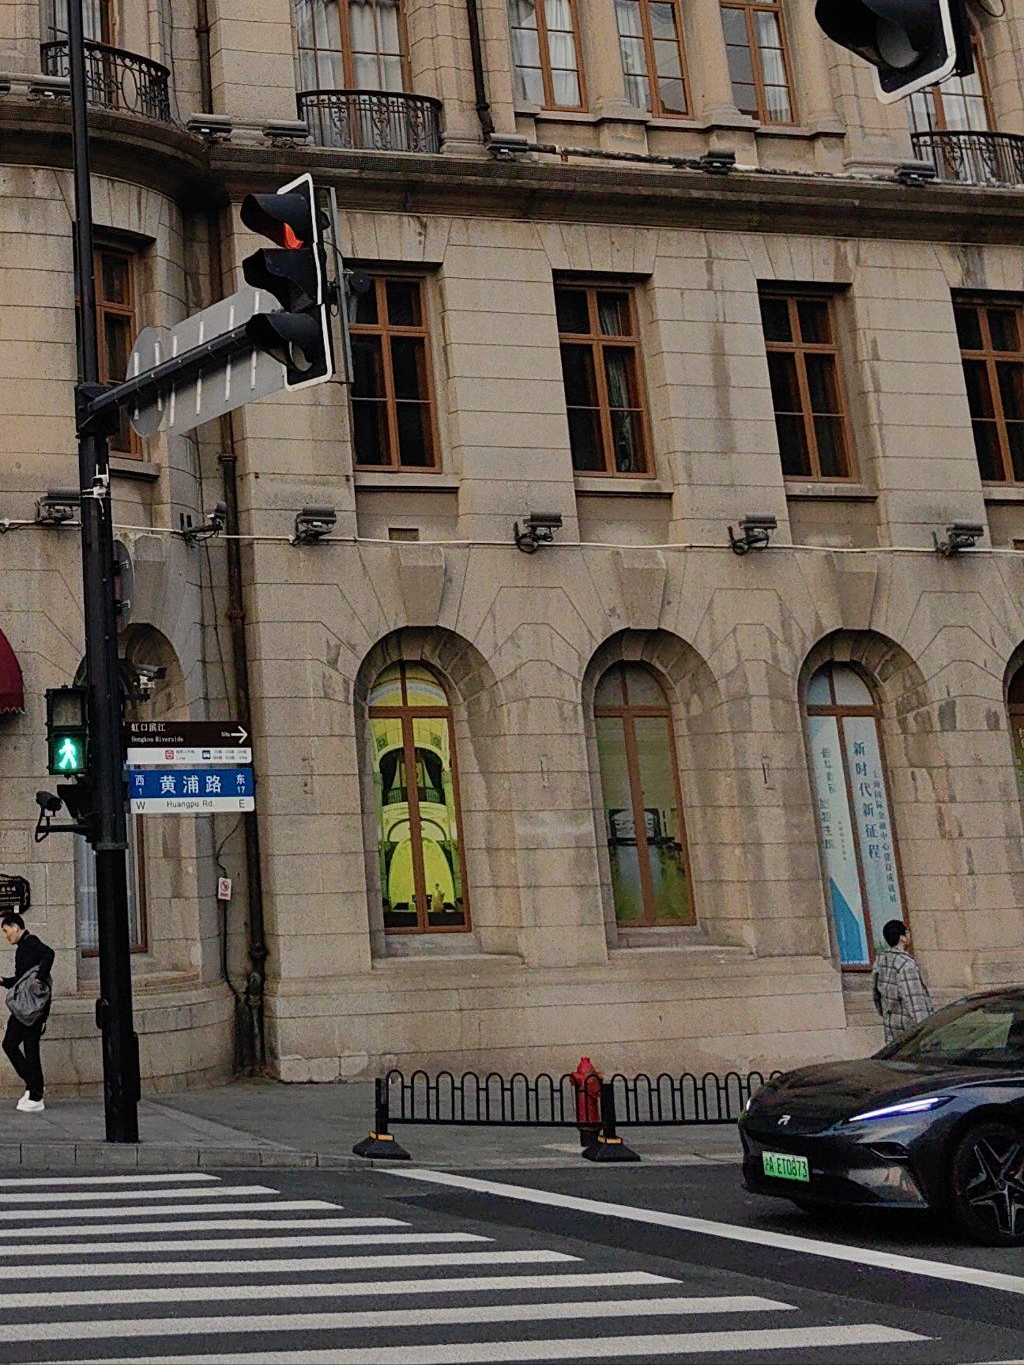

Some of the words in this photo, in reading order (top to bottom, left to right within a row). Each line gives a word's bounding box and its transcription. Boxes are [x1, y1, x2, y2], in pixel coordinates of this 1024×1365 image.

[131, 723, 166, 732] 虹口滨江
[134, 774, 145, 786] 西
[159, 774, 222, 794] 黄浦路
[236, 773, 246, 785] 东
[237, 786, 246, 794] 17
[136, 801, 145, 810] W
[166, 800, 200, 809] Huangpu
[238, 799, 245, 808] E
[853, 741, 881, 859] 新时代新征程
